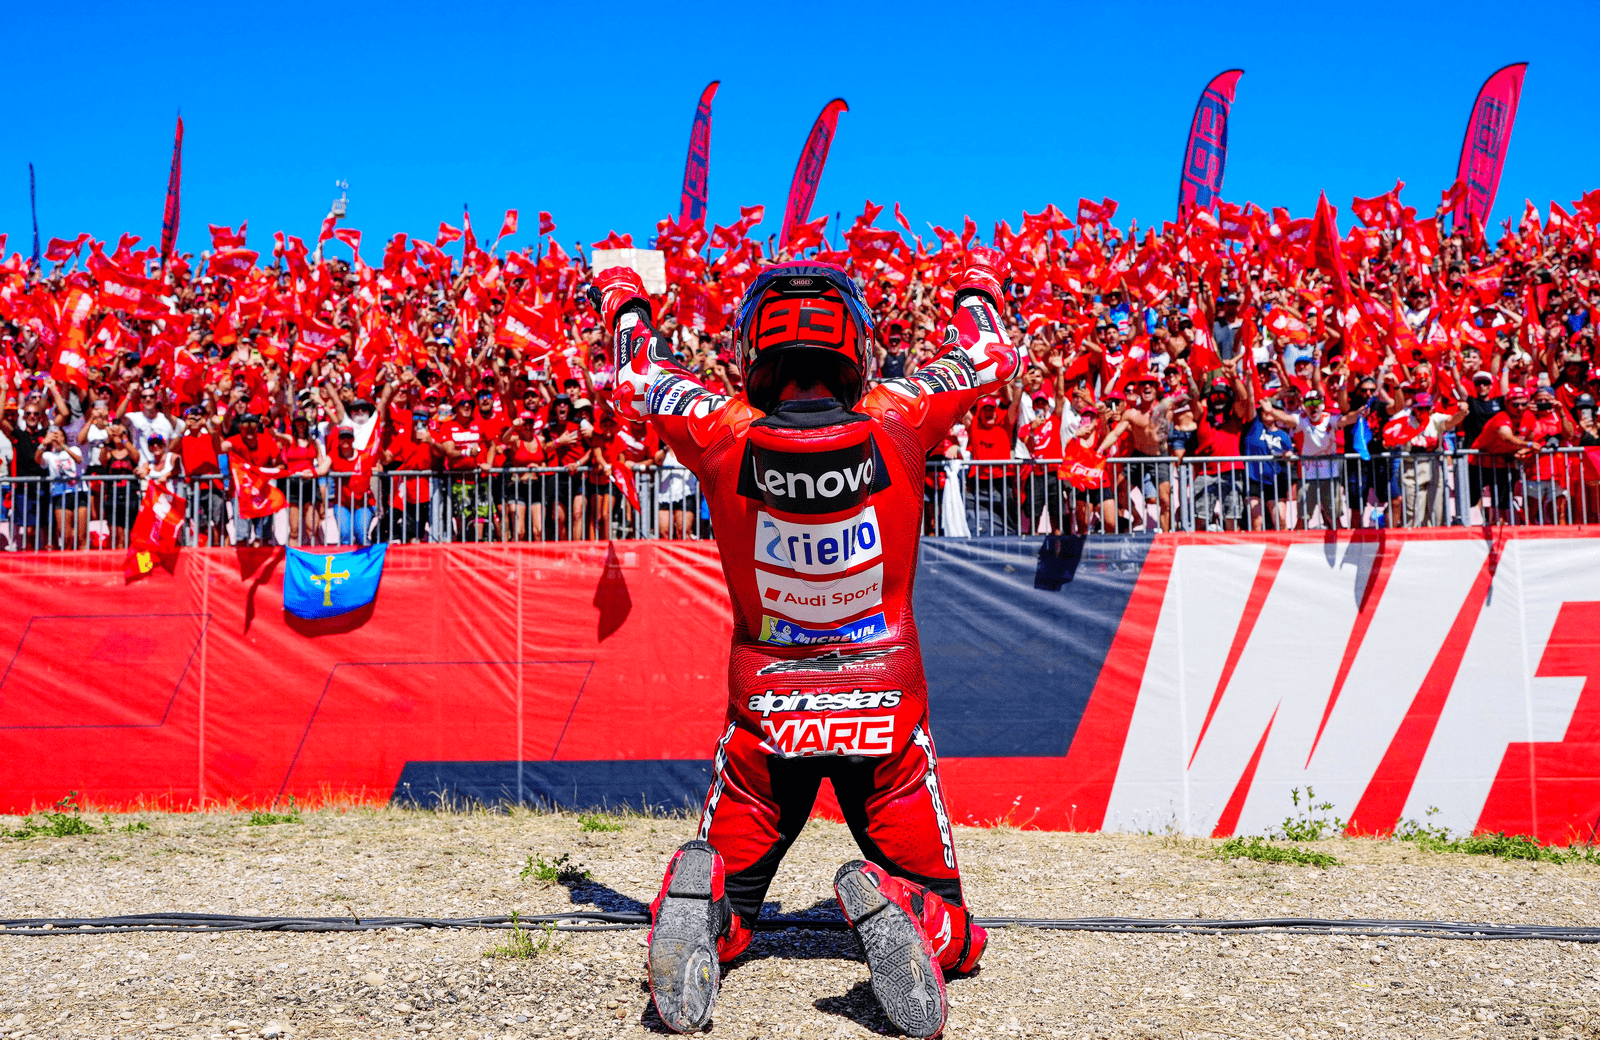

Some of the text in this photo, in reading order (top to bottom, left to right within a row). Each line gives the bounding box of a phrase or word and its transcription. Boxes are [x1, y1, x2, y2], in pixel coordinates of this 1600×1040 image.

[758, 298, 845, 350] 93
[620, 328, 631, 364] Lenovo
[664, 385, 687, 412] riello
[752, 455, 873, 499] Lenovo
[787, 521, 876, 566] riello
[783, 582, 879, 607] Audi Sport
[794, 624, 876, 644] MICHELIN
[748, 688, 903, 718] alpinestars
[761, 715, 895, 757] MARC
